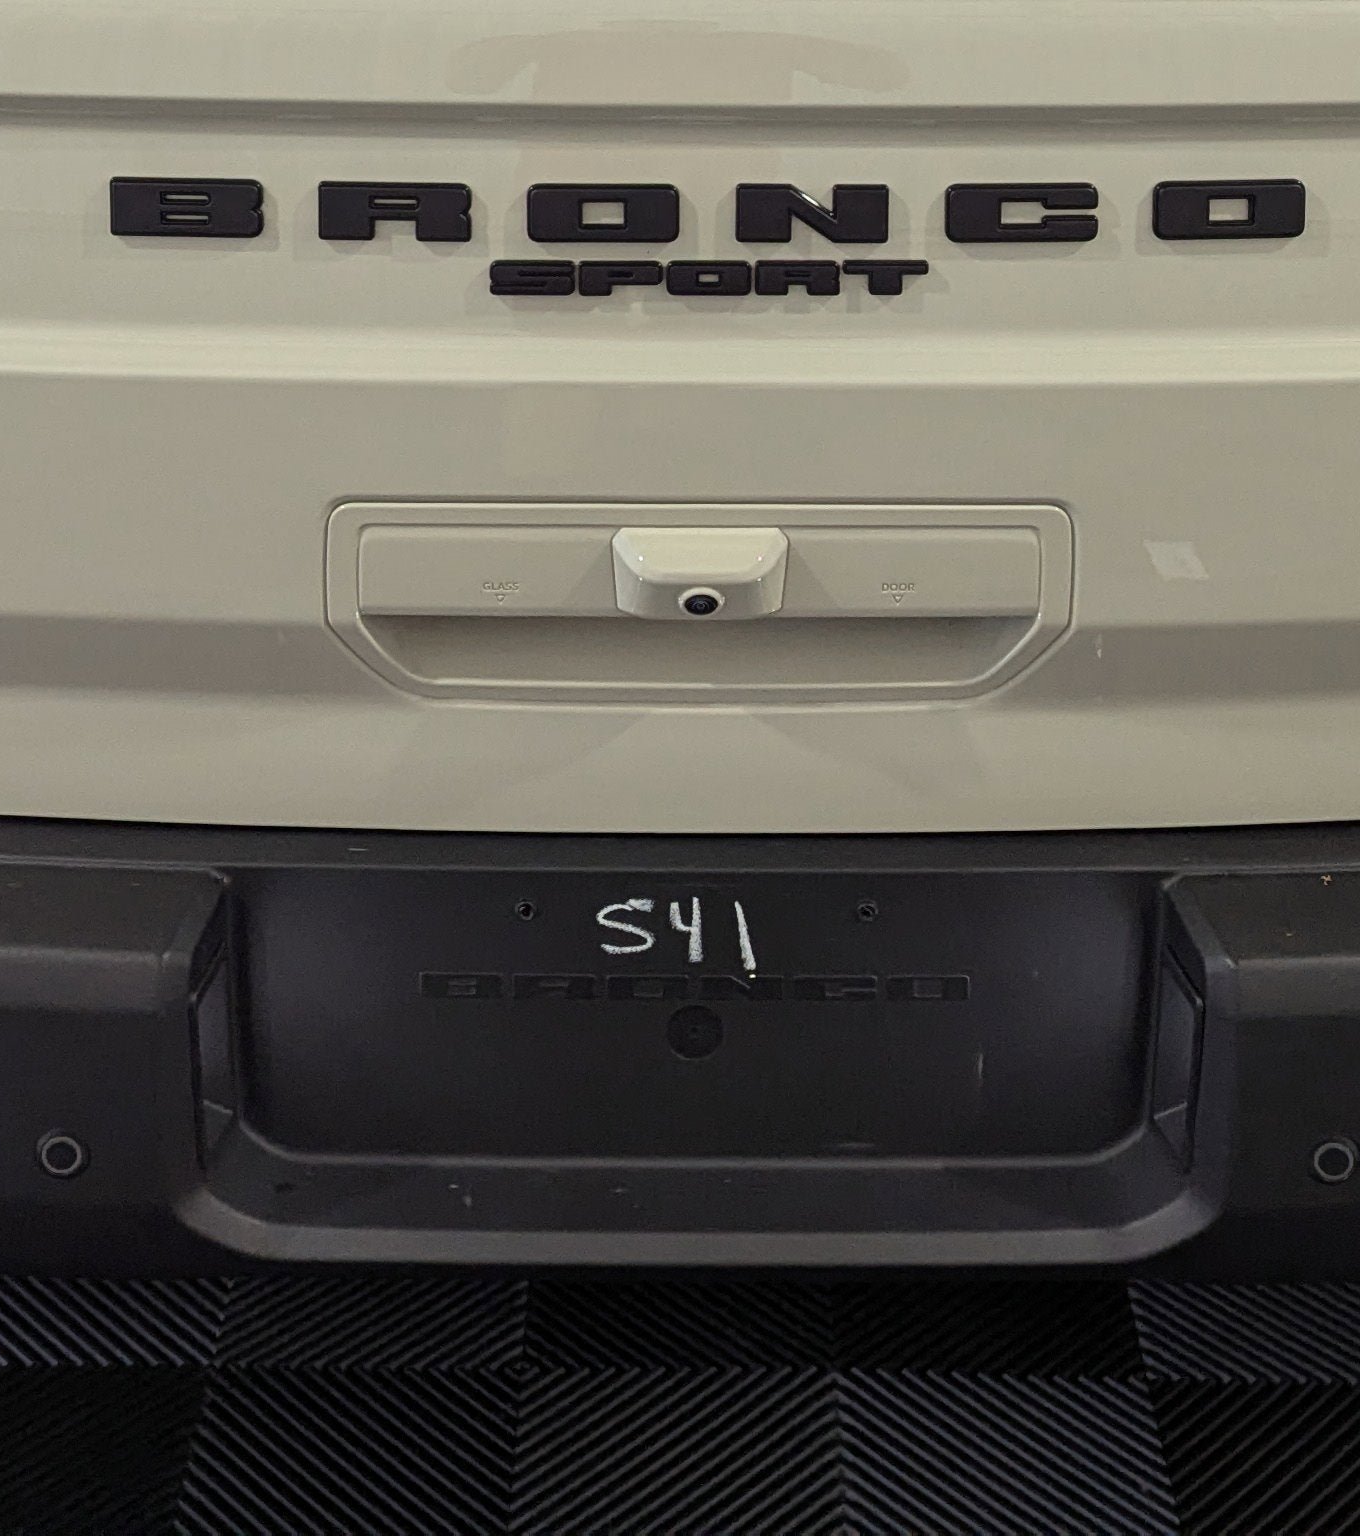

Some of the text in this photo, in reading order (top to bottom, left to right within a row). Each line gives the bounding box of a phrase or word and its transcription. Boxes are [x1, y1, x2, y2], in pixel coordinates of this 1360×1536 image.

[108, 176, 1307, 245] BRONCO
[489, 259, 930, 297] SPORT
[482, 582, 520, 591] GLASS
[881, 582, 916, 593] DOOR
[419, 971, 971, 1000] BRONCO
